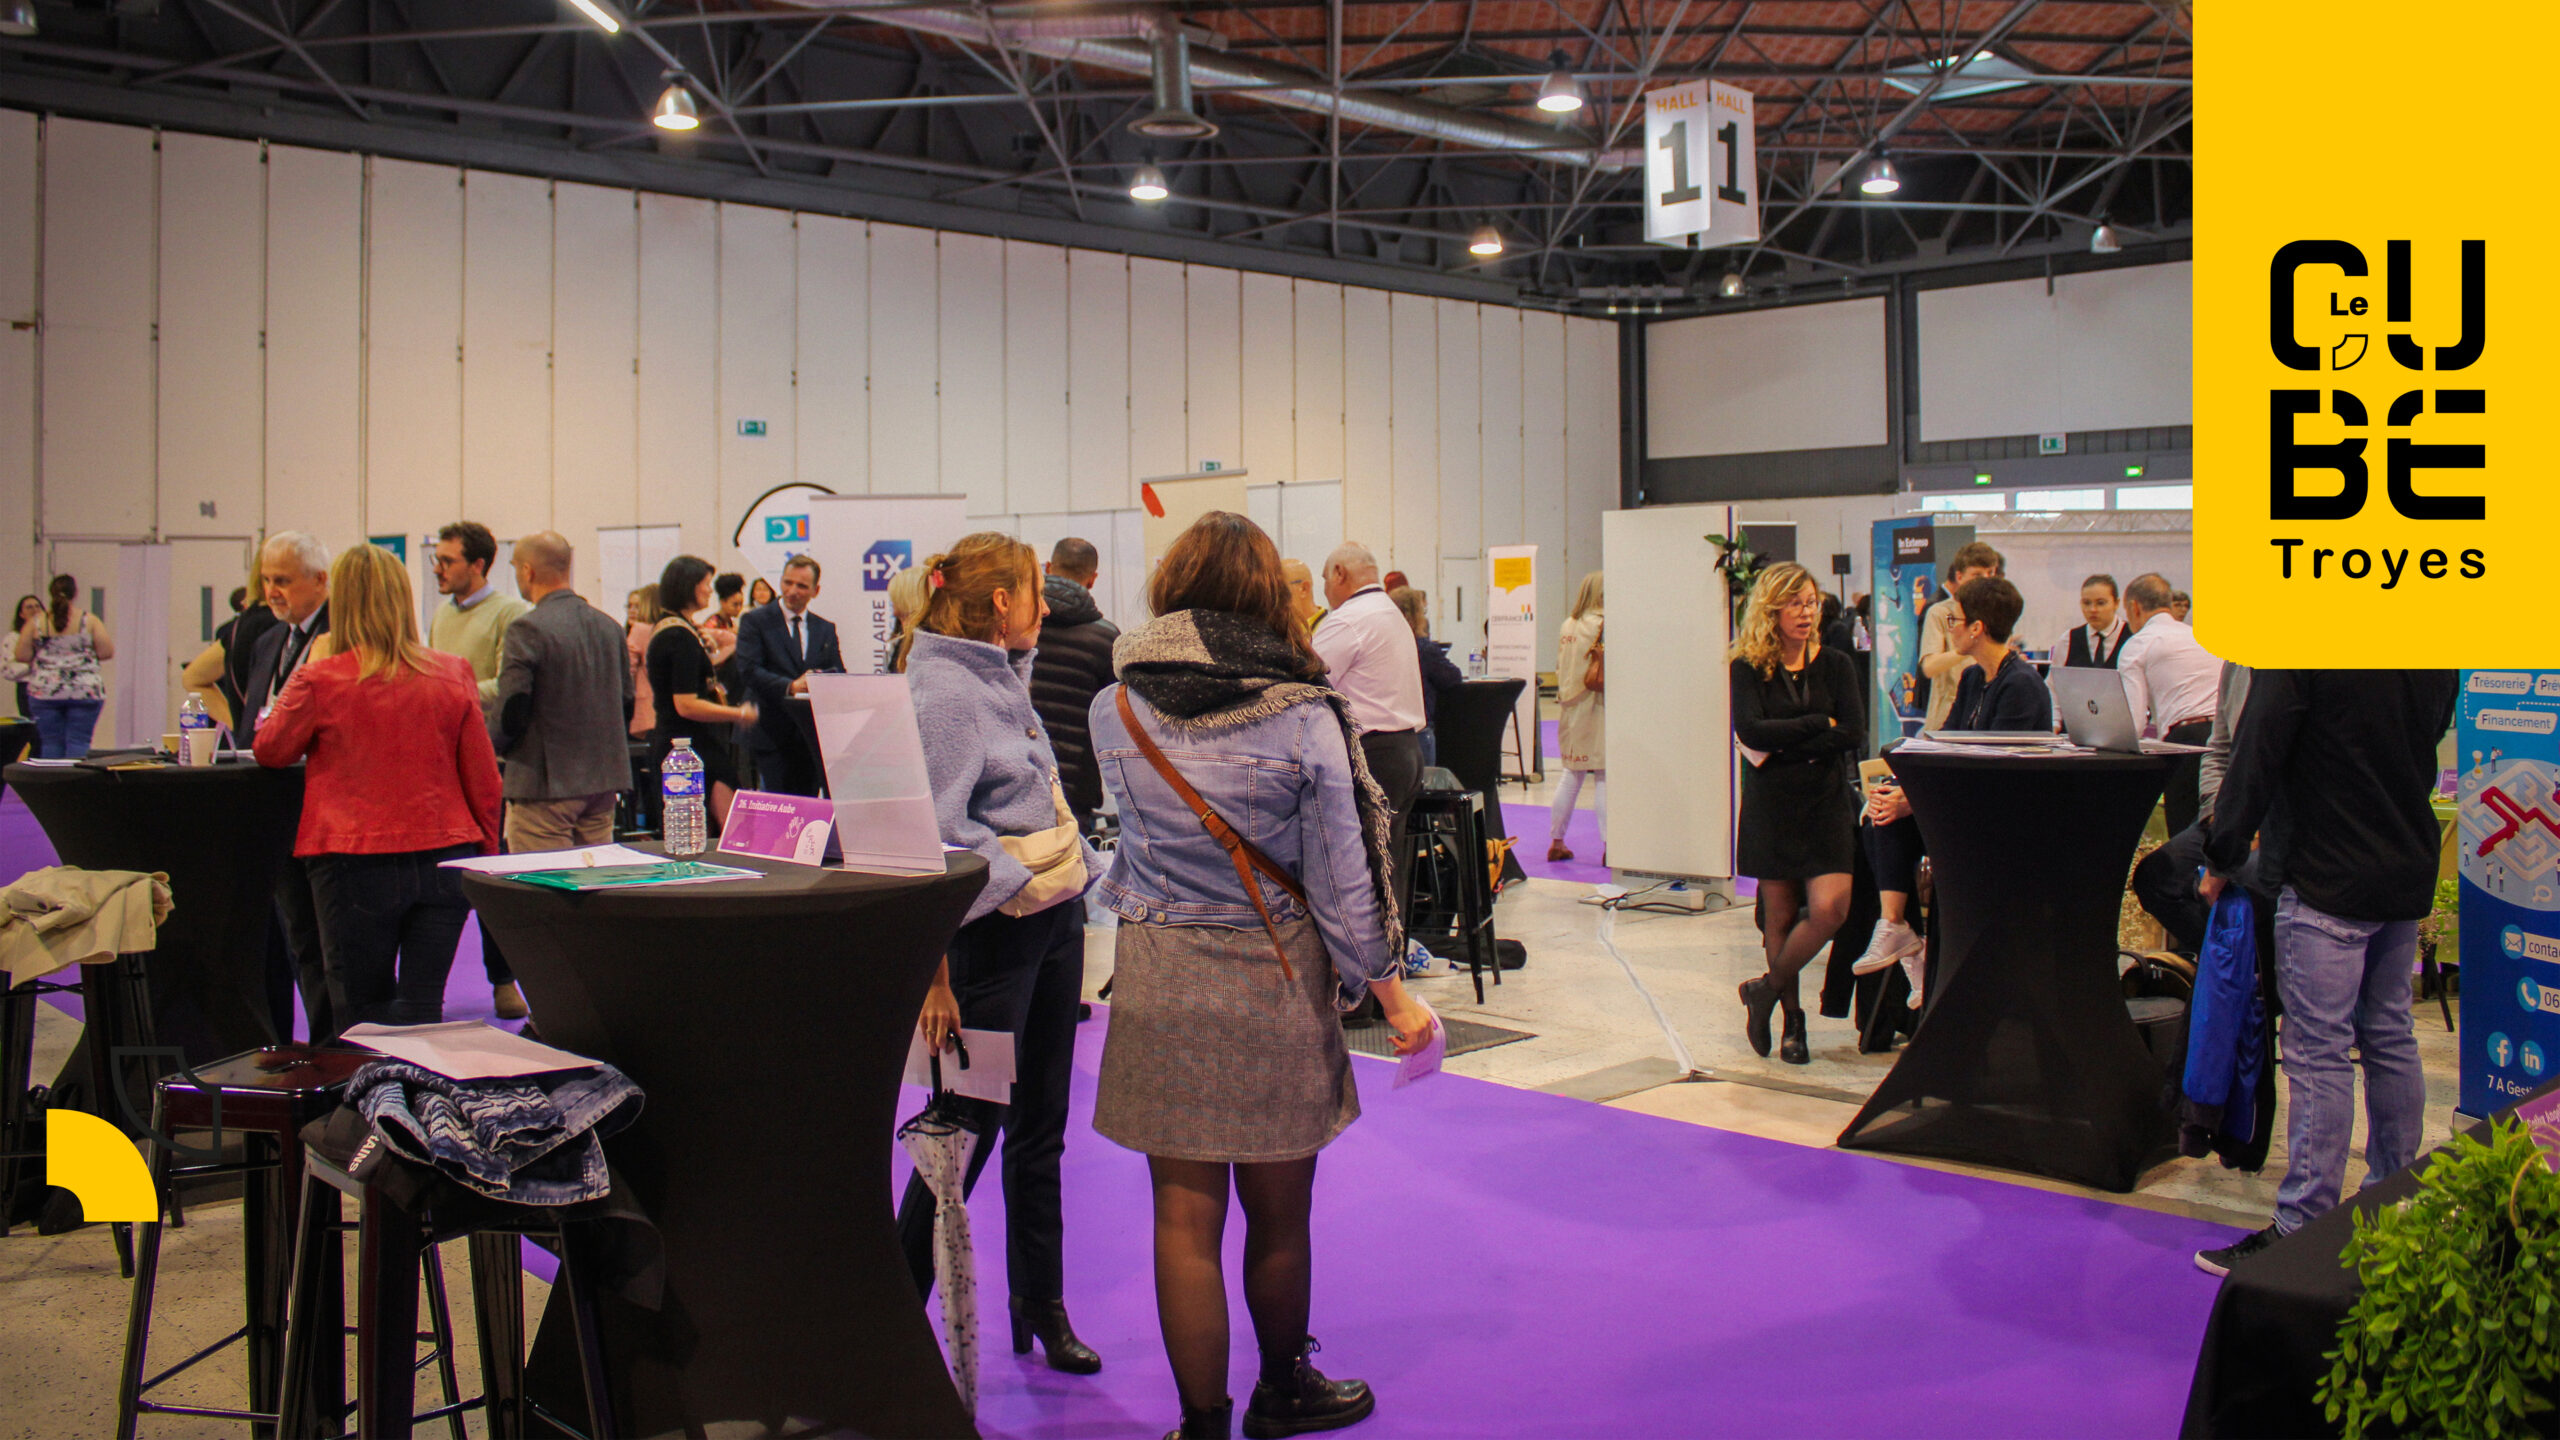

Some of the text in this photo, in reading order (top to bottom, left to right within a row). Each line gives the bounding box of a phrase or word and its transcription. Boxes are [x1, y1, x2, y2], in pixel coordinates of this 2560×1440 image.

[1656, 91, 1698, 114] HALL
[1716, 91, 1746, 114] HALL
[1659, 120, 1702, 206] 1
[1717, 120, 1746, 206] 1
[2473, 676, 2526, 689] Trésorerie
[2481, 713, 2551, 729] Financement
[2529, 941, 2560, 958] conta
[2544, 991, 2560, 1009] 06
[2487, 1074, 2494, 1089] 7
[2496, 1077, 2505, 1092] A
